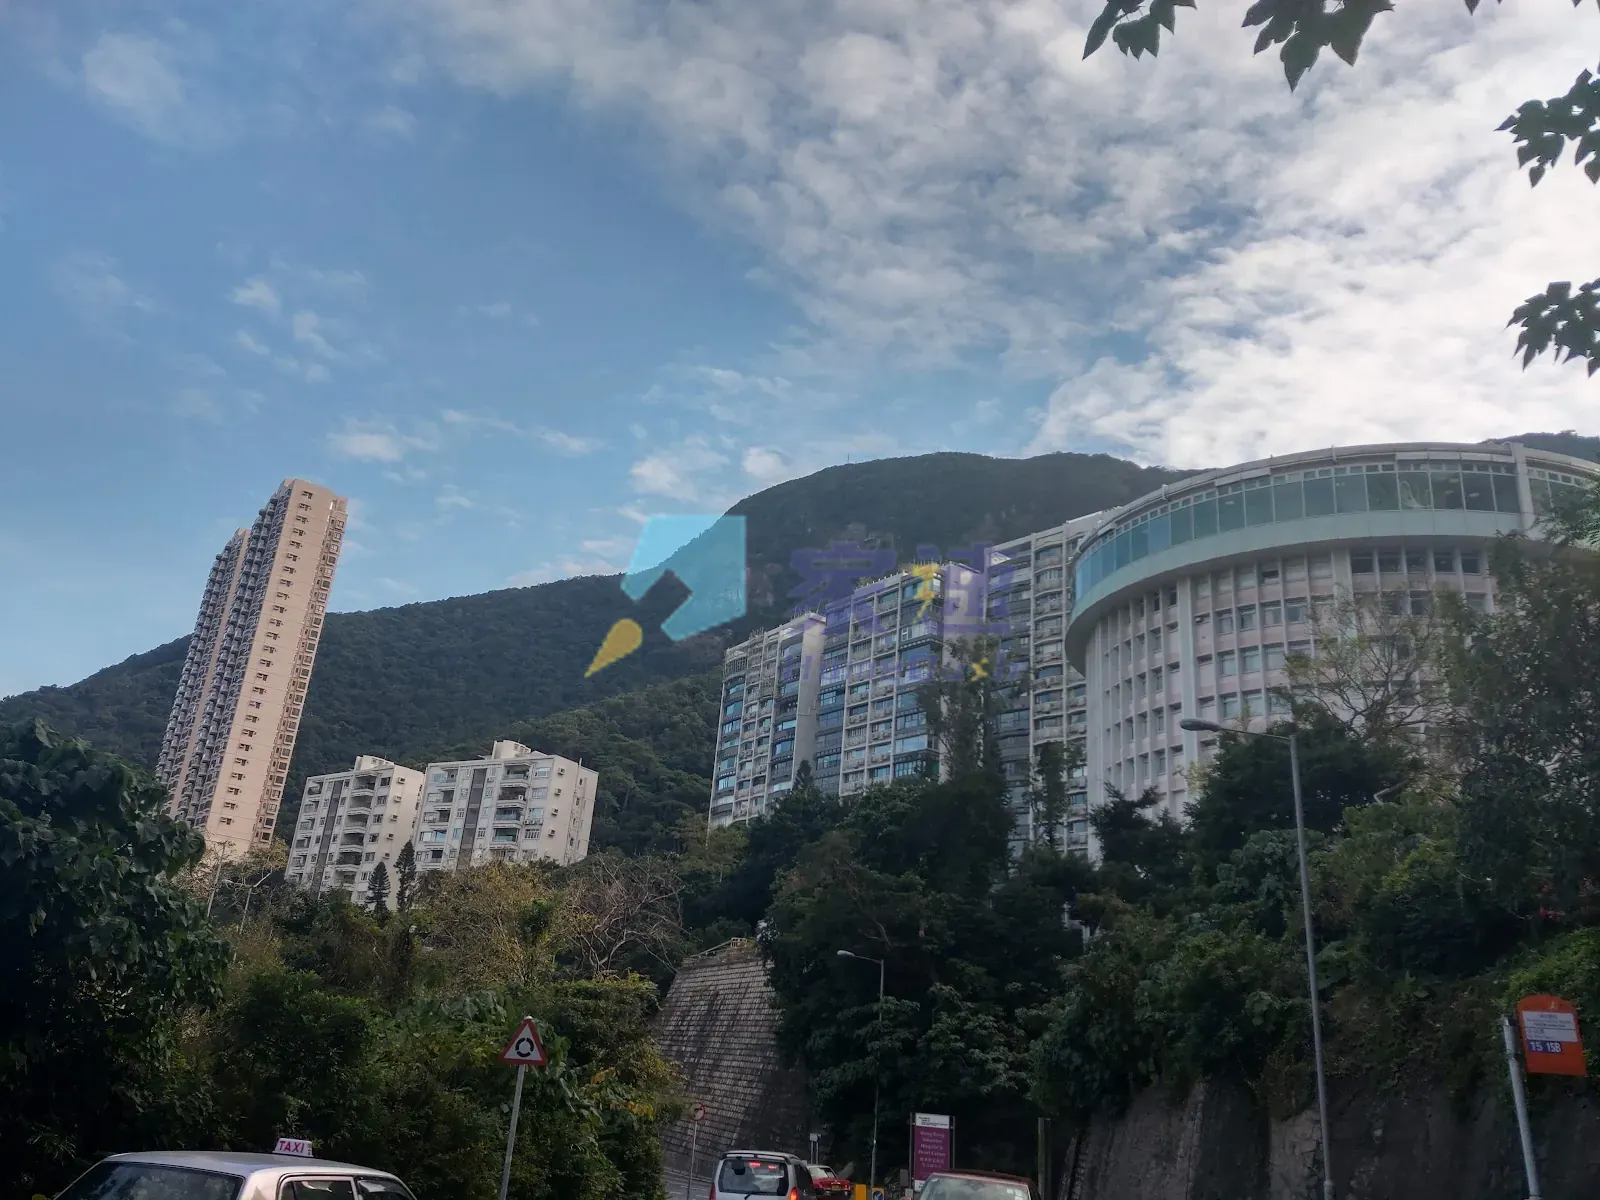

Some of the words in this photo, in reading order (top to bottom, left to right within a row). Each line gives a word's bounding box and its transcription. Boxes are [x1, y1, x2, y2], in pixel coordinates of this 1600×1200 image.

[1529, 1041, 1543, 1051] 15
[1547, 1042, 1562, 1053] 15B
[280, 1141, 305, 1154] TAXI
